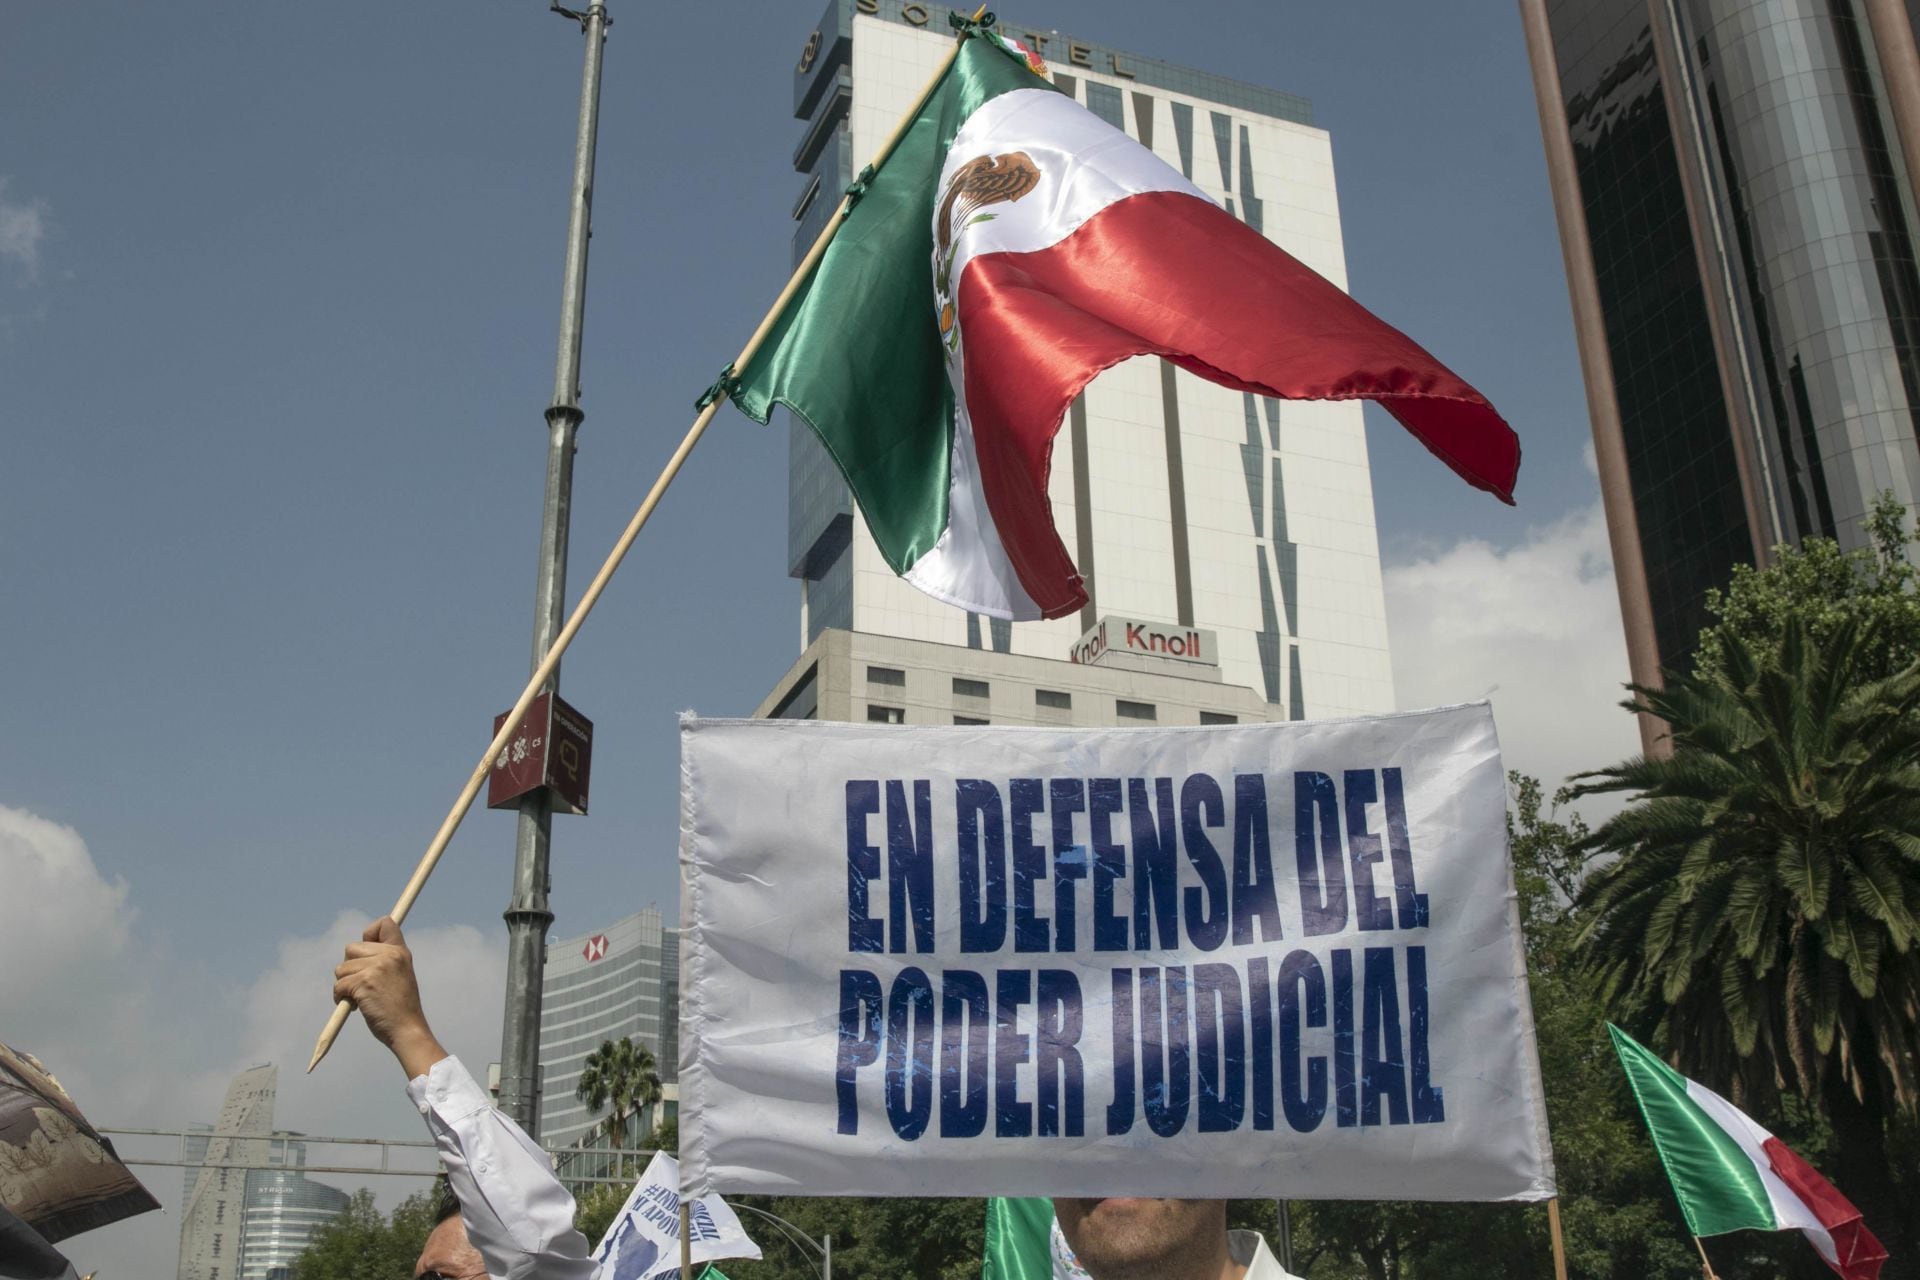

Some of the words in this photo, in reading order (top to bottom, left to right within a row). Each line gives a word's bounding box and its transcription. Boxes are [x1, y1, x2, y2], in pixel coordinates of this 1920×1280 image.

[1070, 622, 1107, 664] Knoll
[1126, 622, 1200, 657] Knoll
[845, 779, 935, 954] EN
[956, 773, 1283, 953] DEFENSA
[1294, 767, 1429, 937] DEL
[836, 966, 1085, 1142] PODER
[1106, 945, 1446, 1138] JUDICIAL
